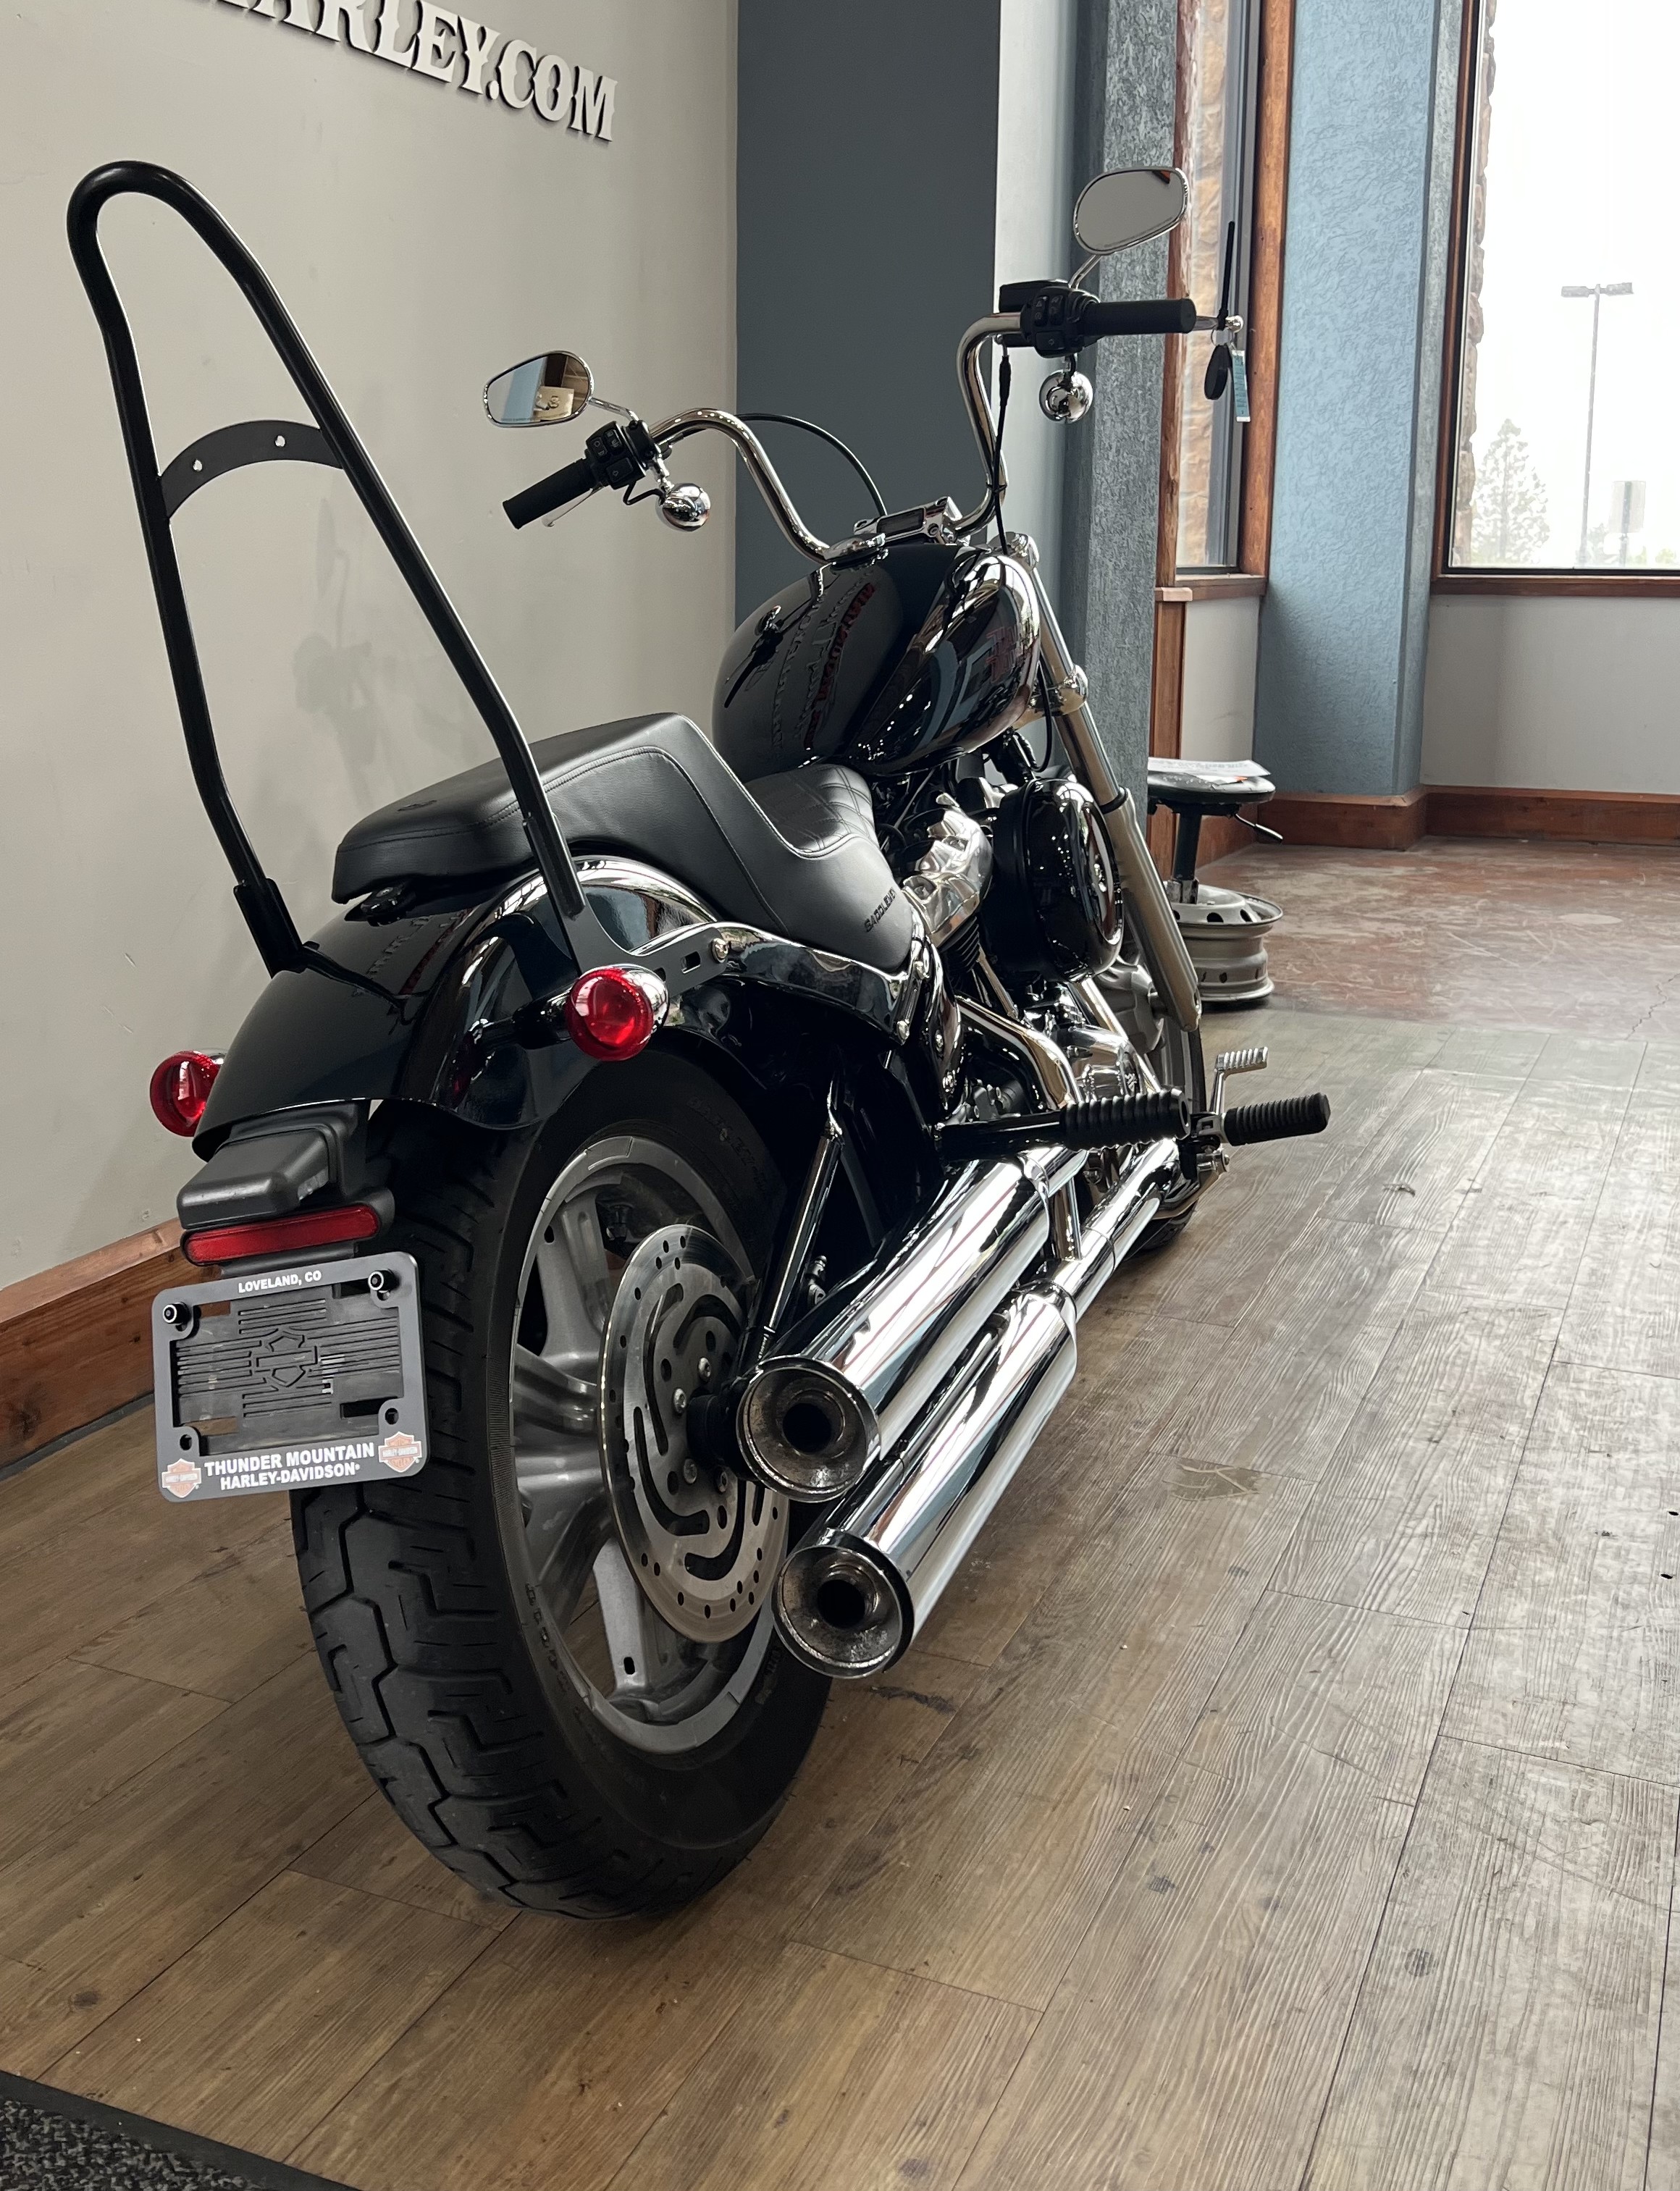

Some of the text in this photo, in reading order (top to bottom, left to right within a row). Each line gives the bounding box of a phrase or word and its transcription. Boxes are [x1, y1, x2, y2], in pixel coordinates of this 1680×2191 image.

[238, 1270, 322, 1292] LOVELAND, CO
[204, 1454, 282, 1476] THUNDER
[286, 1442, 374, 1467] MOUNTAIN
